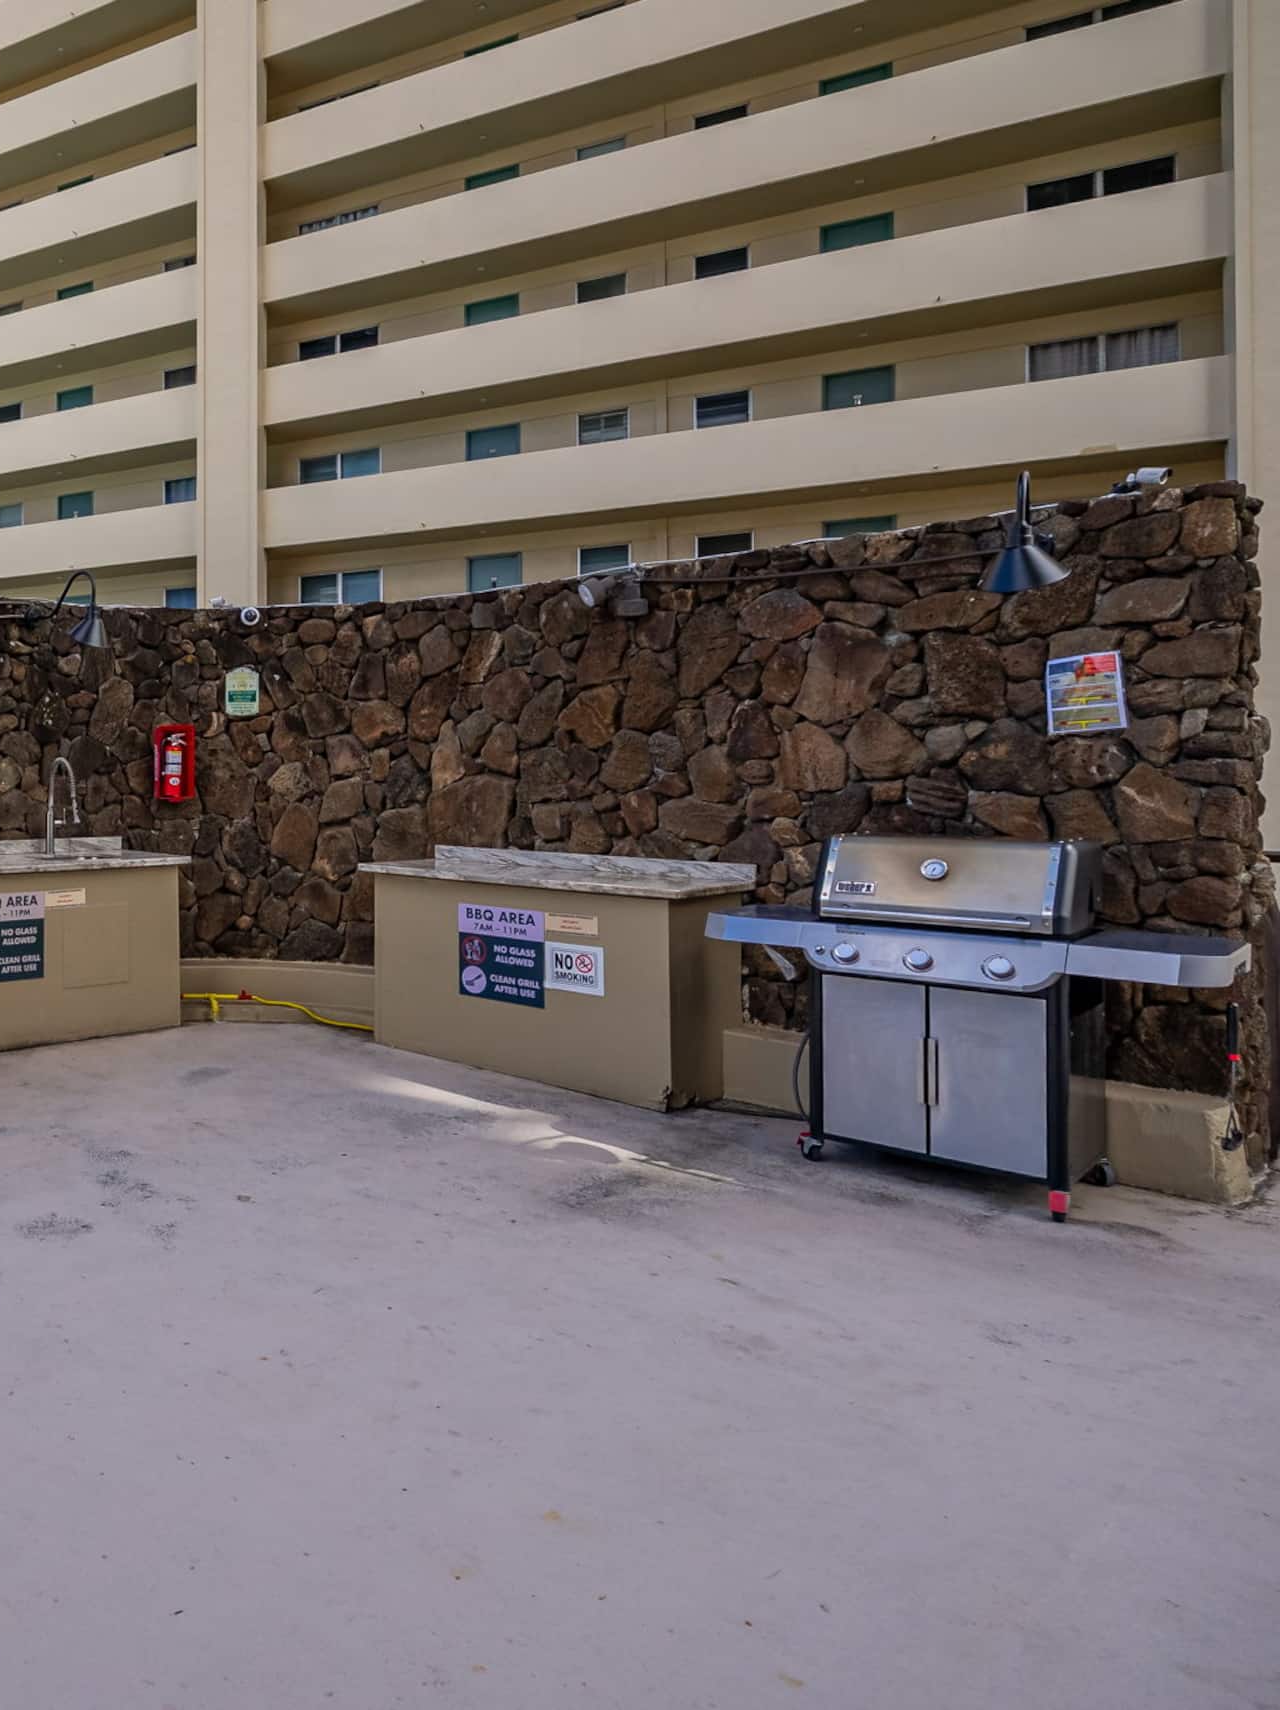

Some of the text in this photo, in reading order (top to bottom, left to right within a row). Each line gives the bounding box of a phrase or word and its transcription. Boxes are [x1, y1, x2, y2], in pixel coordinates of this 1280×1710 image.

[6, 895, 38, 908] AREA
[10, 909, 31, 917] 11PM
[466, 907, 494, 922] BBQ
[498, 911, 536, 926] AREA
[0, 926, 38, 937] NO GLASS
[474, 923, 493, 931] 7AM
[503, 926, 528, 936] 11PM
[2, 935, 37, 946] ALLOWED
[493, 944, 536, 958] NO GLASS
[22, 954, 41, 963] GRILL
[495, 954, 534, 967] ALLOWED
[555, 953, 573, 970] NO
[1, 963, 37, 974] AFTER USE
[490, 974, 540, 989] CLEAN GRILL
[554, 971, 594, 985] SMOKING
[494, 984, 536, 998] AFTER USE
